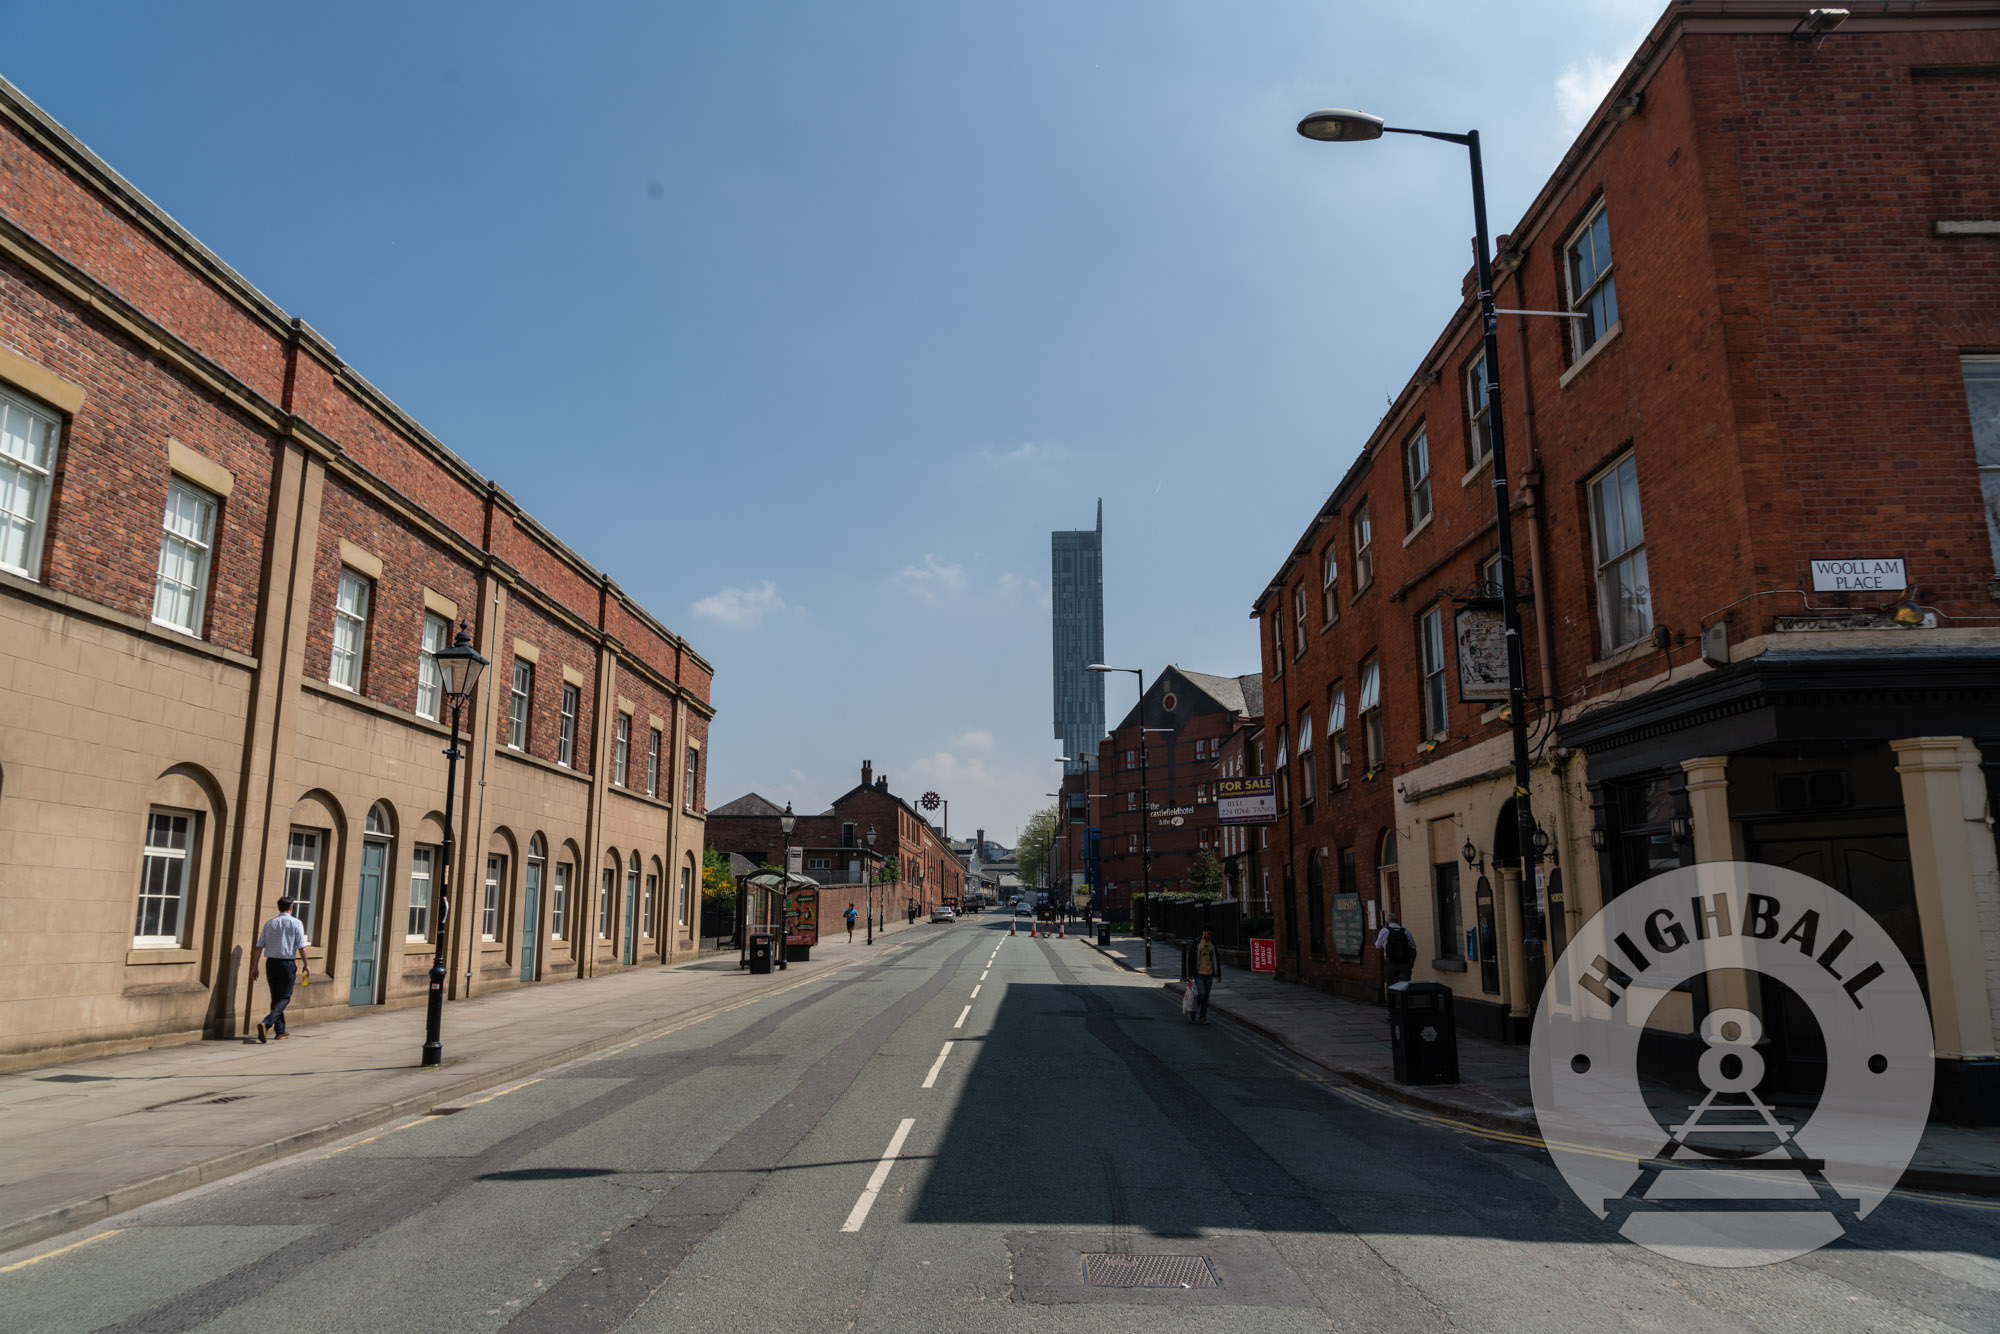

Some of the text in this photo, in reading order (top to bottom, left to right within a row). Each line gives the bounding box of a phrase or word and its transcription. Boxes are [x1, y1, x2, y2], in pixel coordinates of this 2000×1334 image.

[1836, 576, 1883, 589] PLACE
[1461, 609, 1505, 626] WILSON
[1463, 688, 1510, 697] COMMERC
[1219, 778, 1272, 792] FOR SALE
[1150, 802, 1160, 810] the
